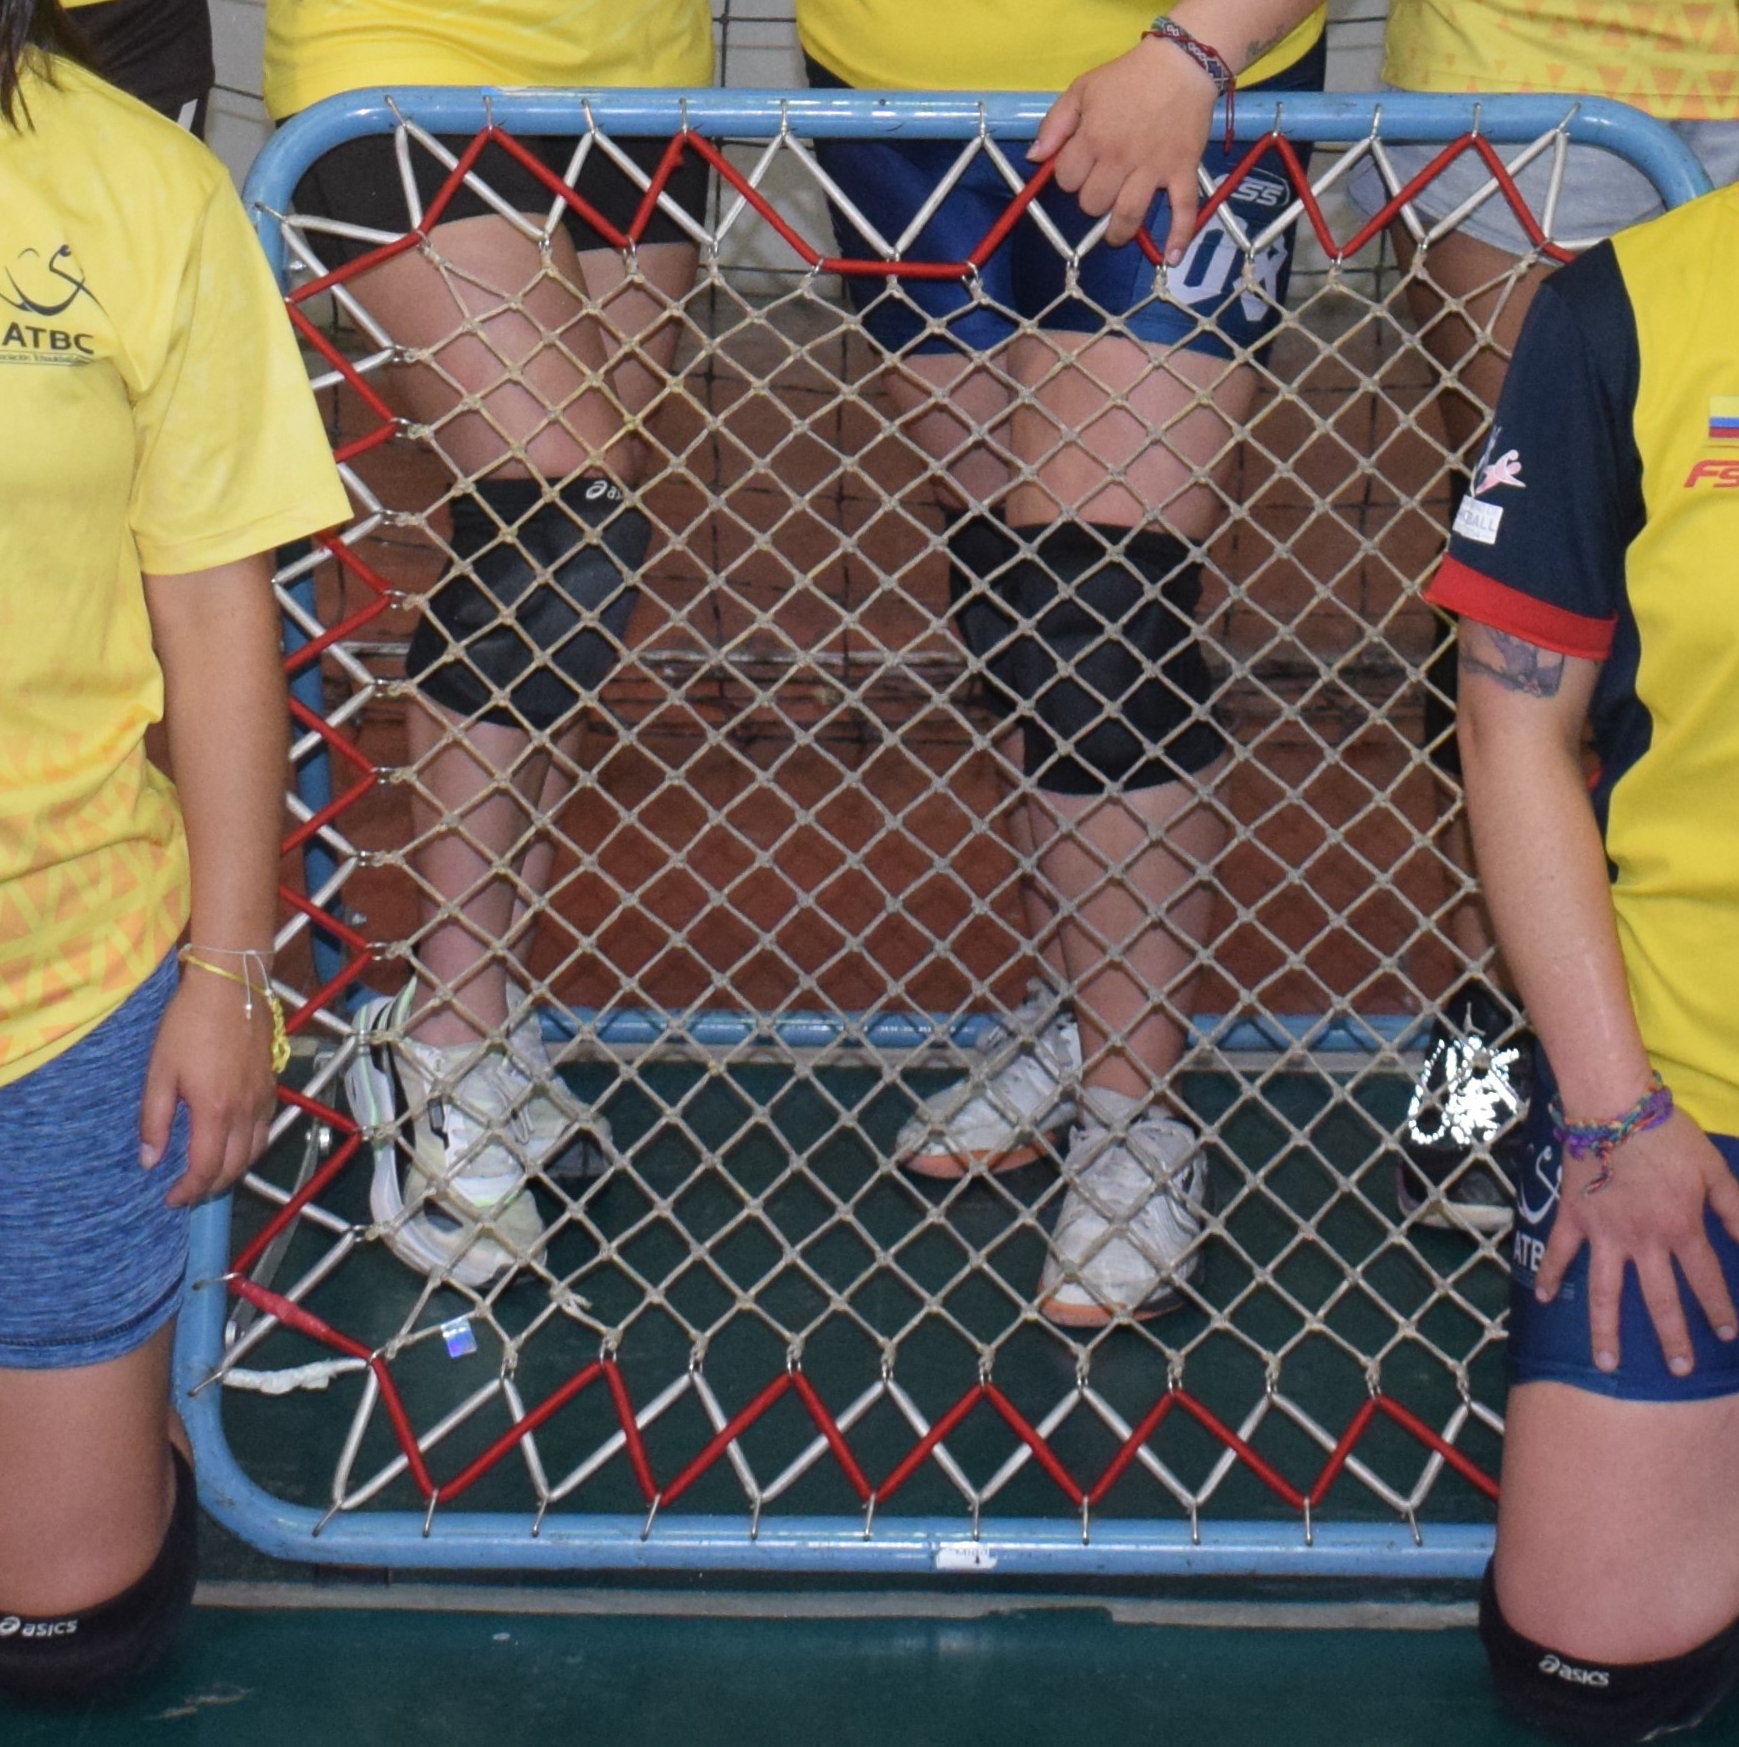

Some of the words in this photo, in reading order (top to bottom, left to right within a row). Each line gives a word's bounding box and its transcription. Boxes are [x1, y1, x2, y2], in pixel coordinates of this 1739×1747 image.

[2, 321, 95, 355] ATBC
[1513, 1229, 1546, 1272] ATB
[22, 1619, 78, 1637] asics
